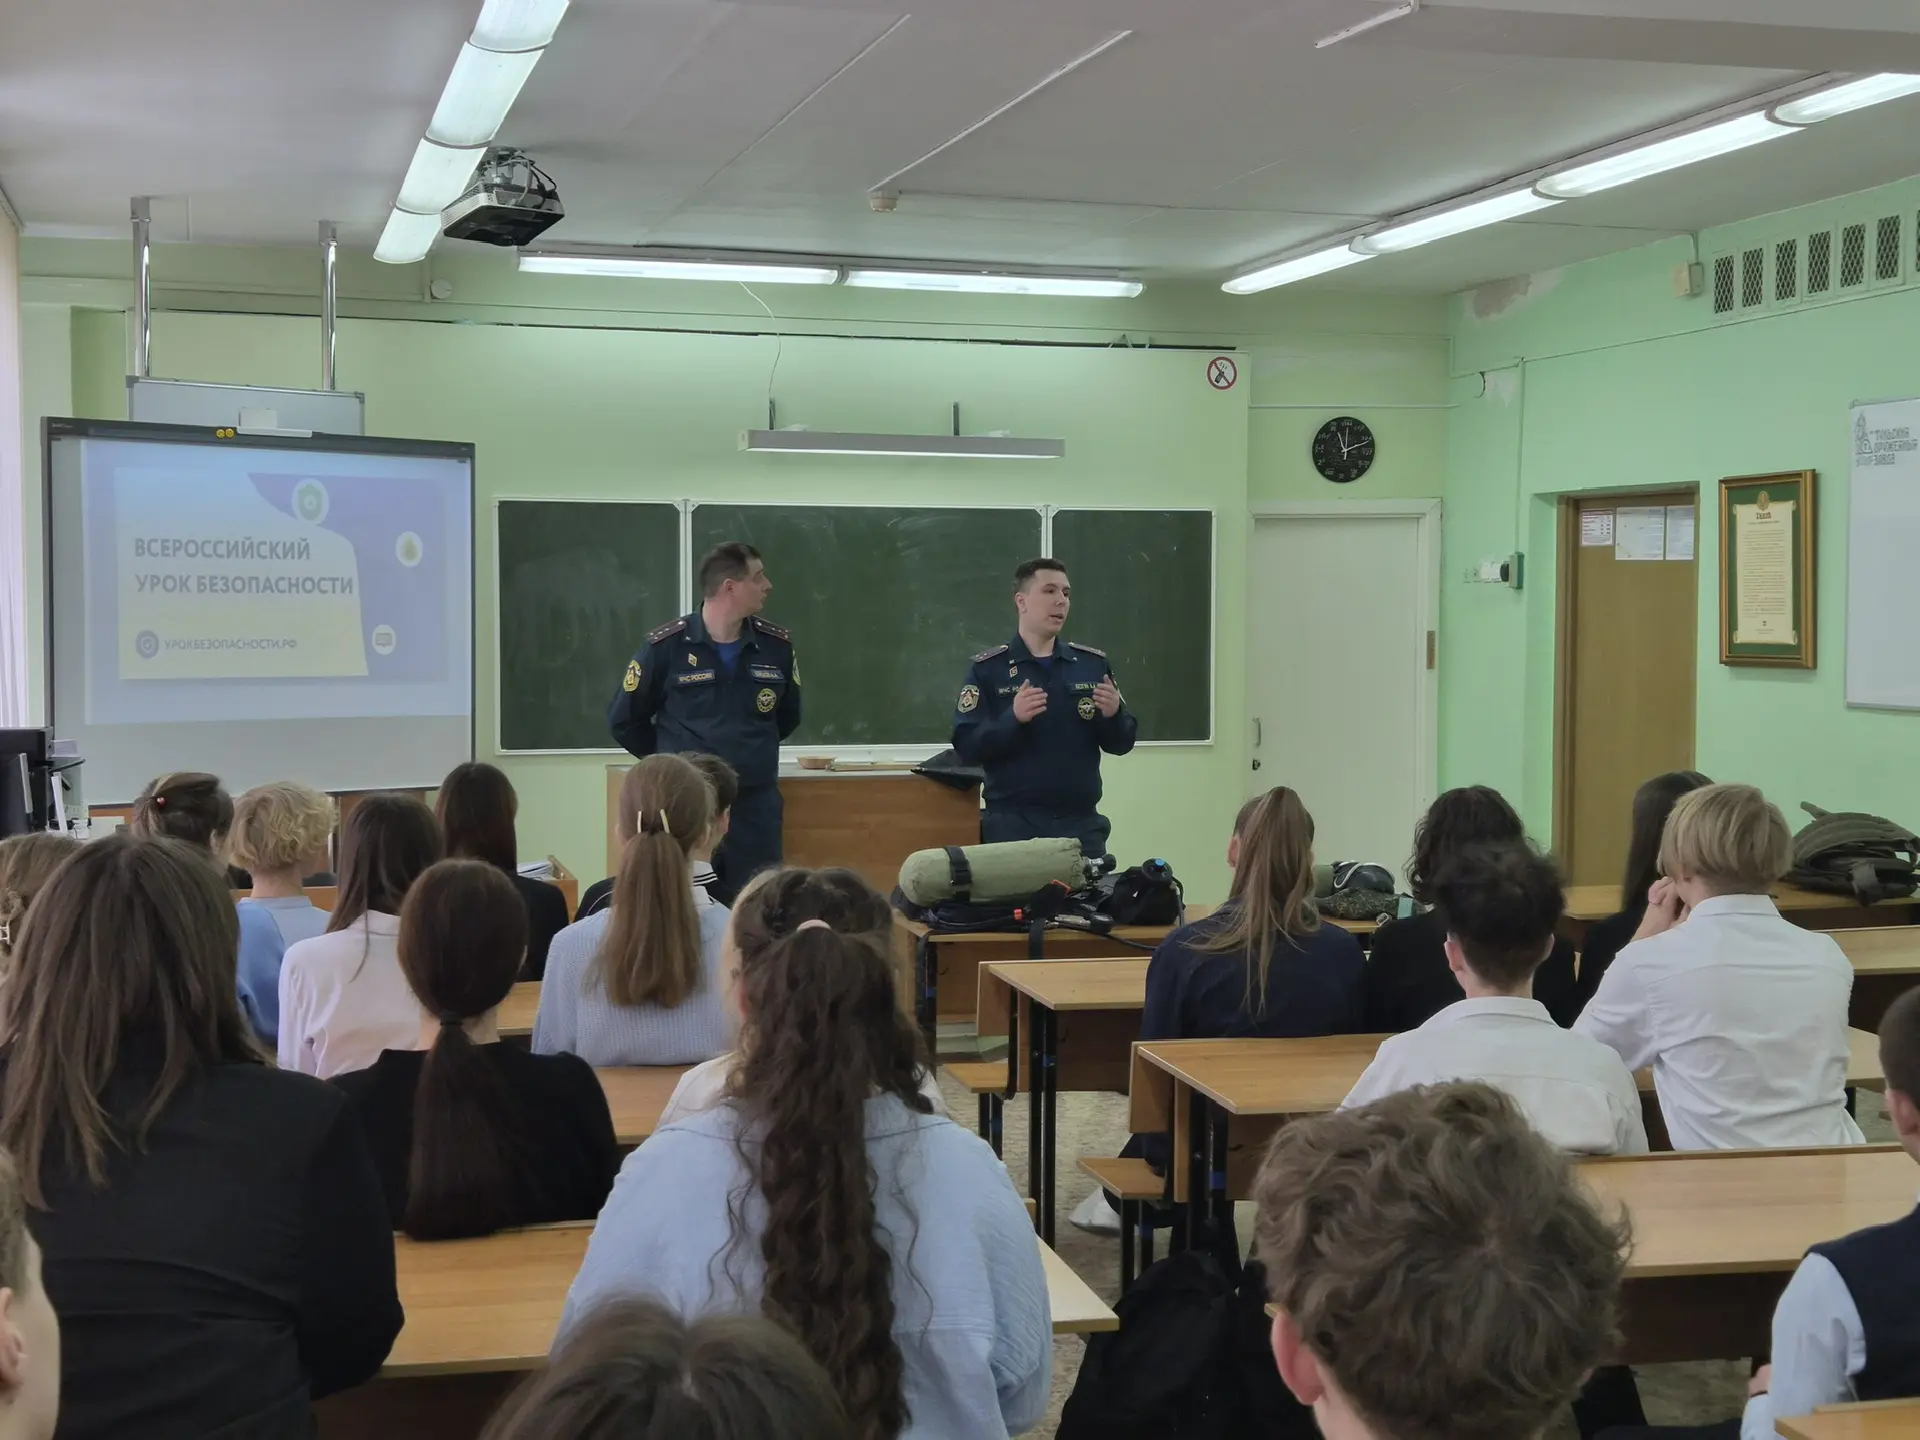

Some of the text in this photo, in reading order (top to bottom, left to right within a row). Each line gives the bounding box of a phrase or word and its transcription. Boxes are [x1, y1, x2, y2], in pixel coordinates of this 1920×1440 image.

[134, 537, 310, 560] ВСЕРОССИЙСКИЙ
[135, 574, 354, 595] УРОК БЕЗОПАСНОСТИ
[164, 638, 298, 650] УРОКБЕЗОПАСНОСТИ.РФ
